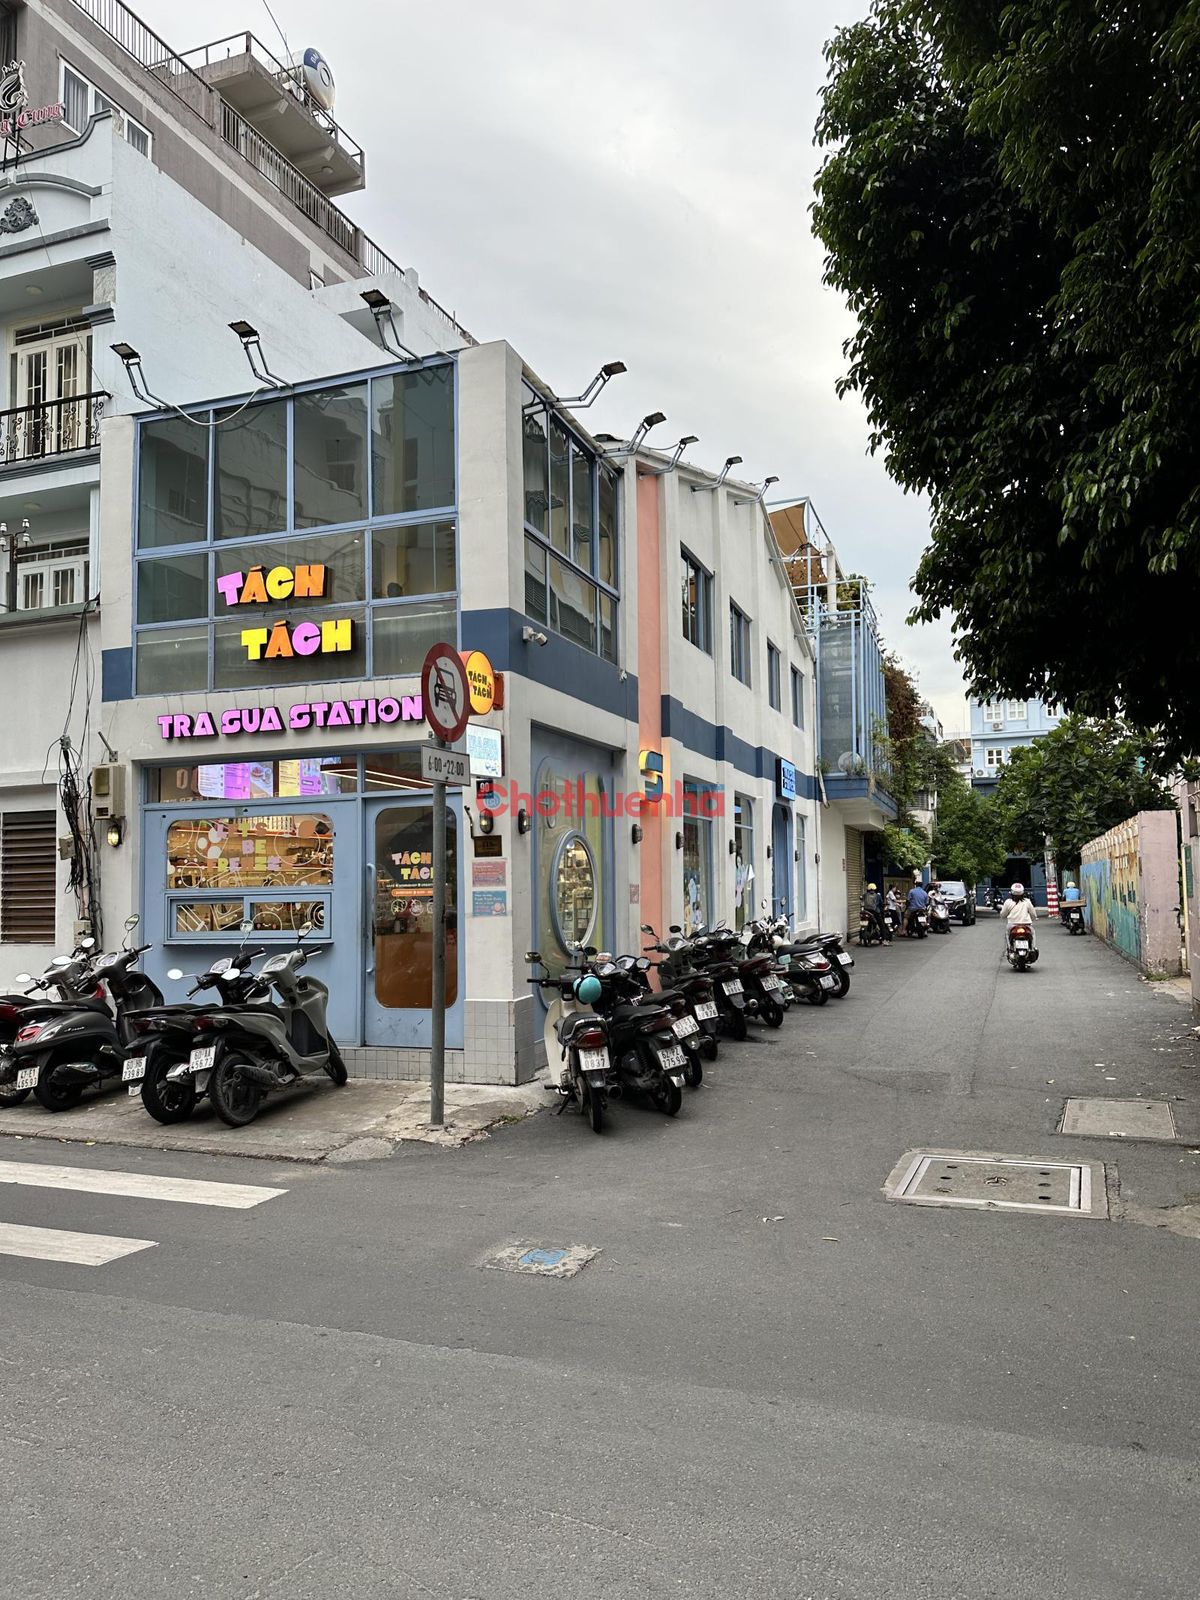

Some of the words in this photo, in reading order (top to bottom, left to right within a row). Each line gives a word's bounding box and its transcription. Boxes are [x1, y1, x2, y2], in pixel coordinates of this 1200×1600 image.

[216, 564, 326, 606] TÁCH
[241, 618, 353, 661] TÁCH
[468, 670, 488, 686] TÁCH
[472, 685, 492, 699] TÁCH
[157, 712, 218, 739] TRA
[221, 706, 285, 734] SUA
[289, 695, 423, 730] STATION
[242, 839, 267, 854] BE
[392, 851, 432, 865] TÁCH
